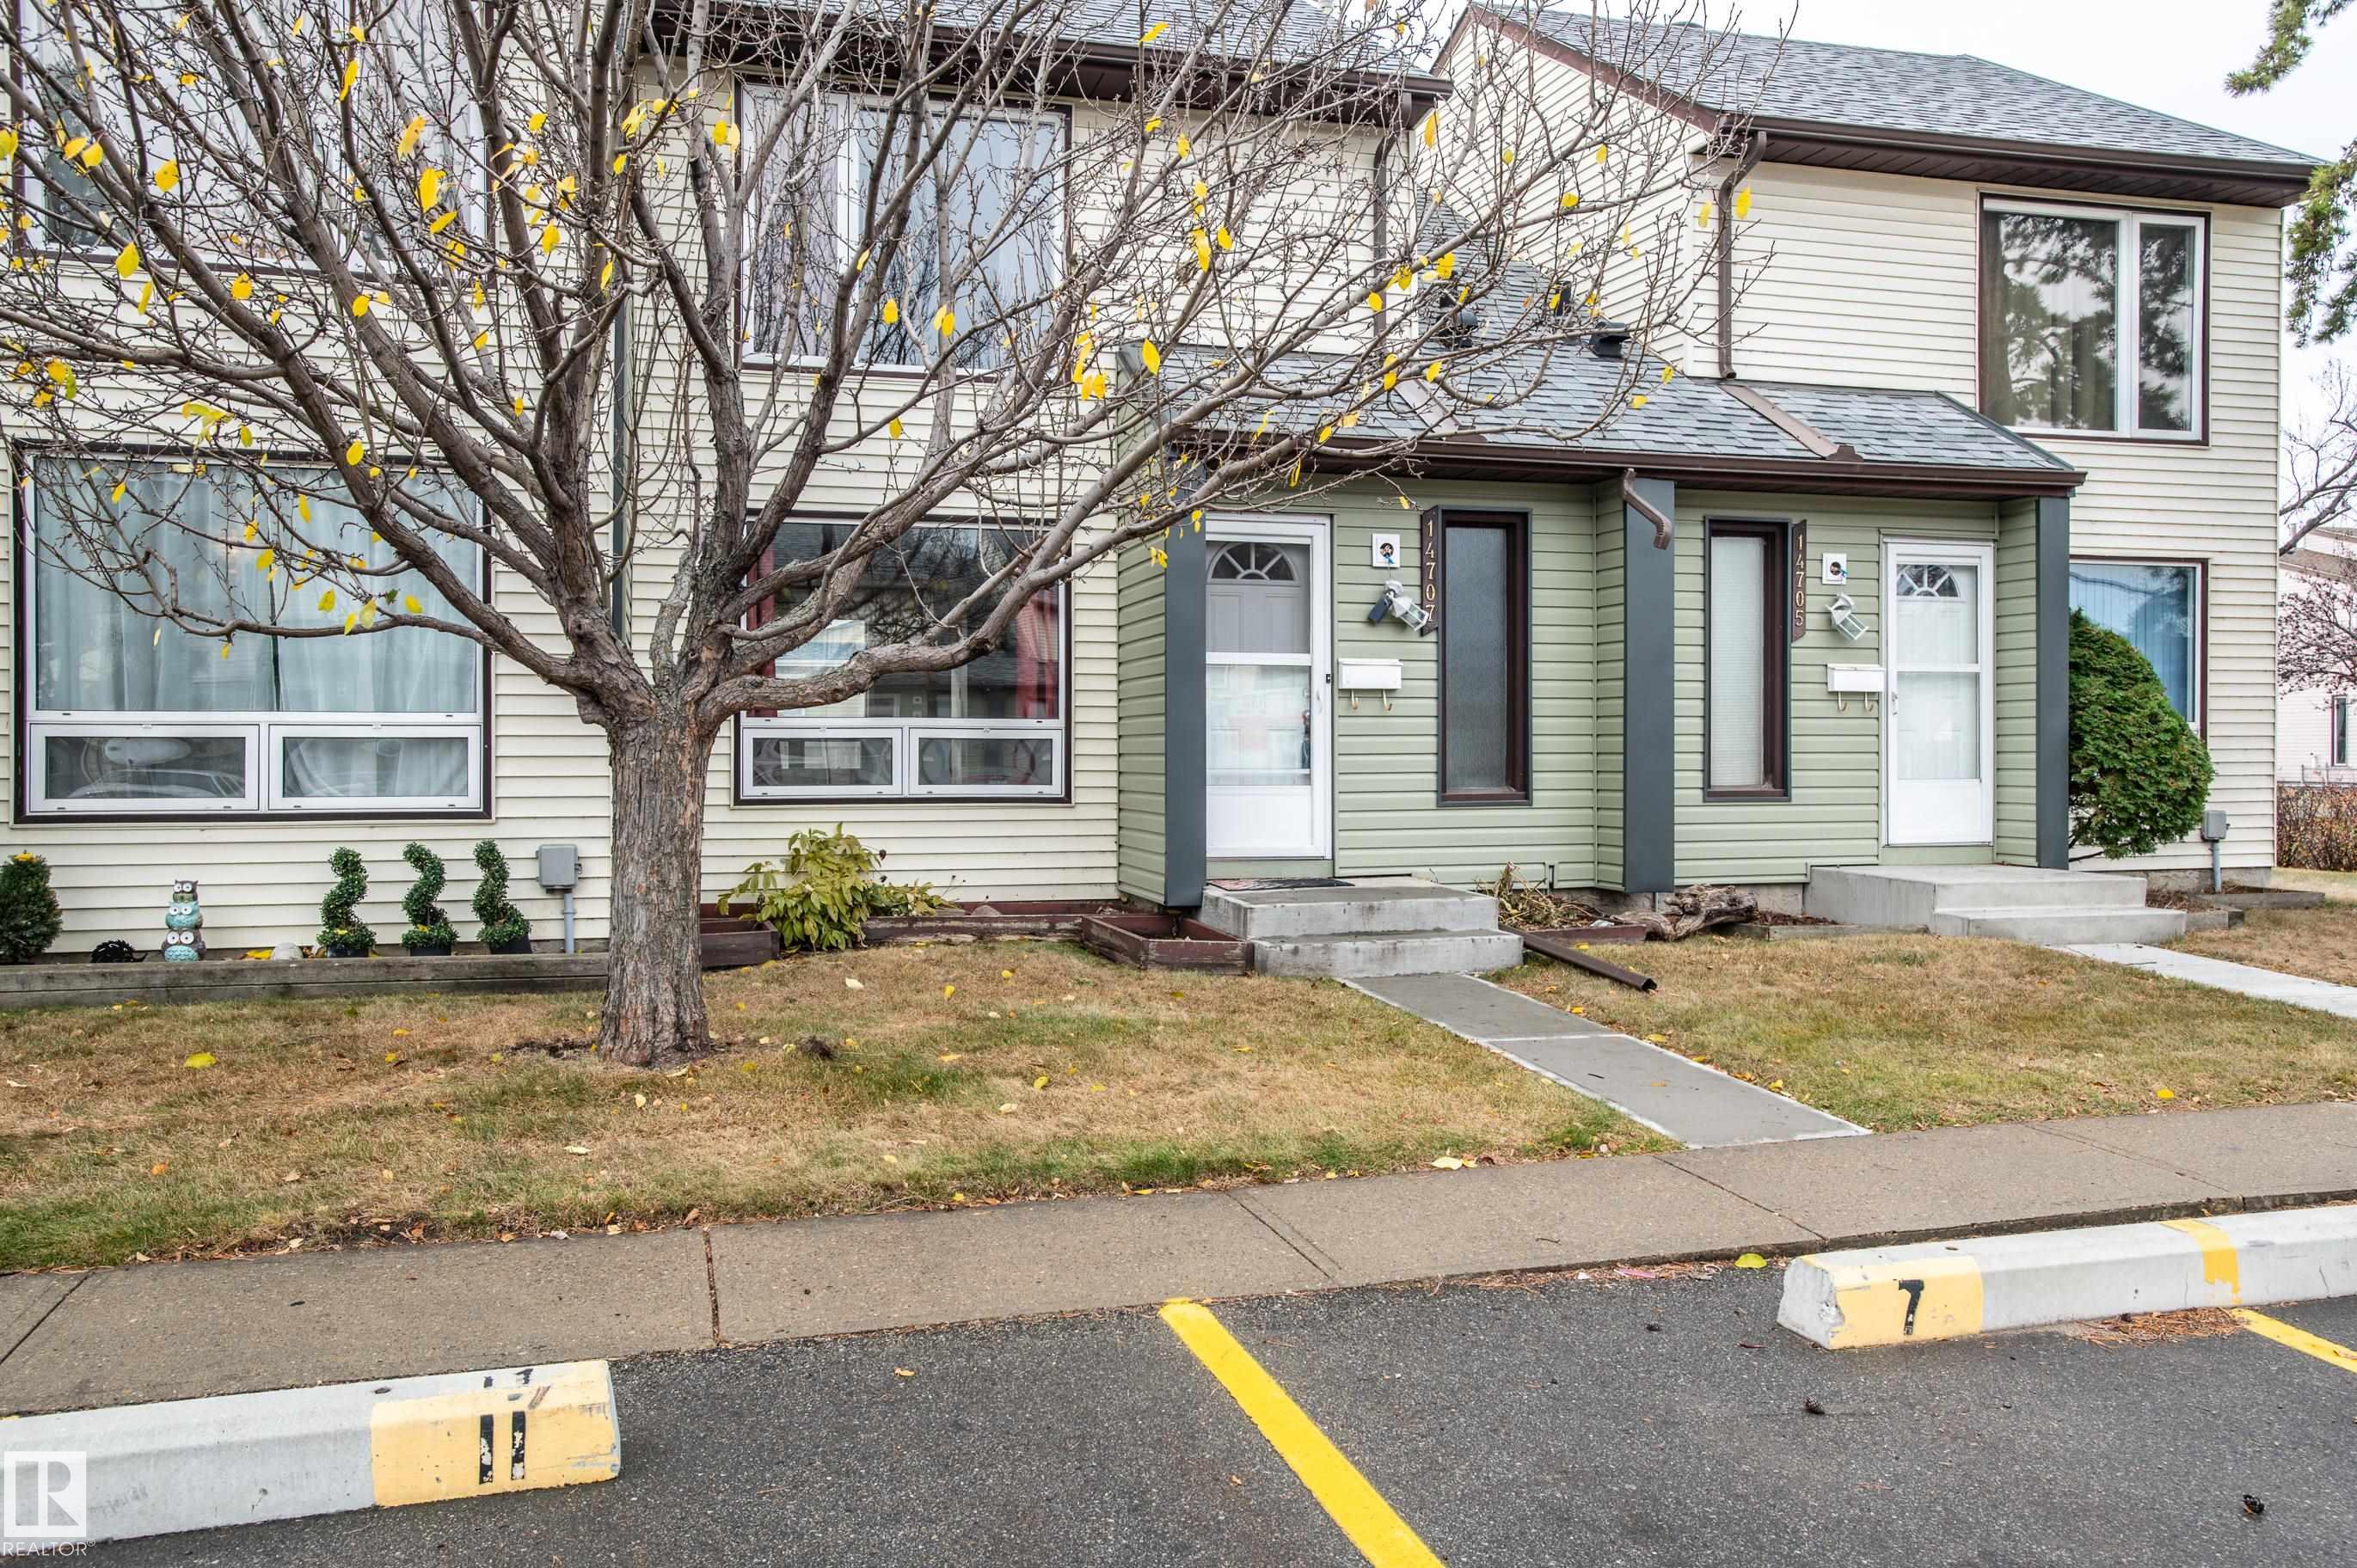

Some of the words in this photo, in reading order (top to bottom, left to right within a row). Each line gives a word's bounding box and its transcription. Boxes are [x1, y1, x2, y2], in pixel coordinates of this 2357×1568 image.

[1424, 519, 1437, 622] 14707
[1794, 533, 1806, 627] 14705
[1898, 1278, 1925, 1336] 7
[478, 1410, 526, 1485] 11
